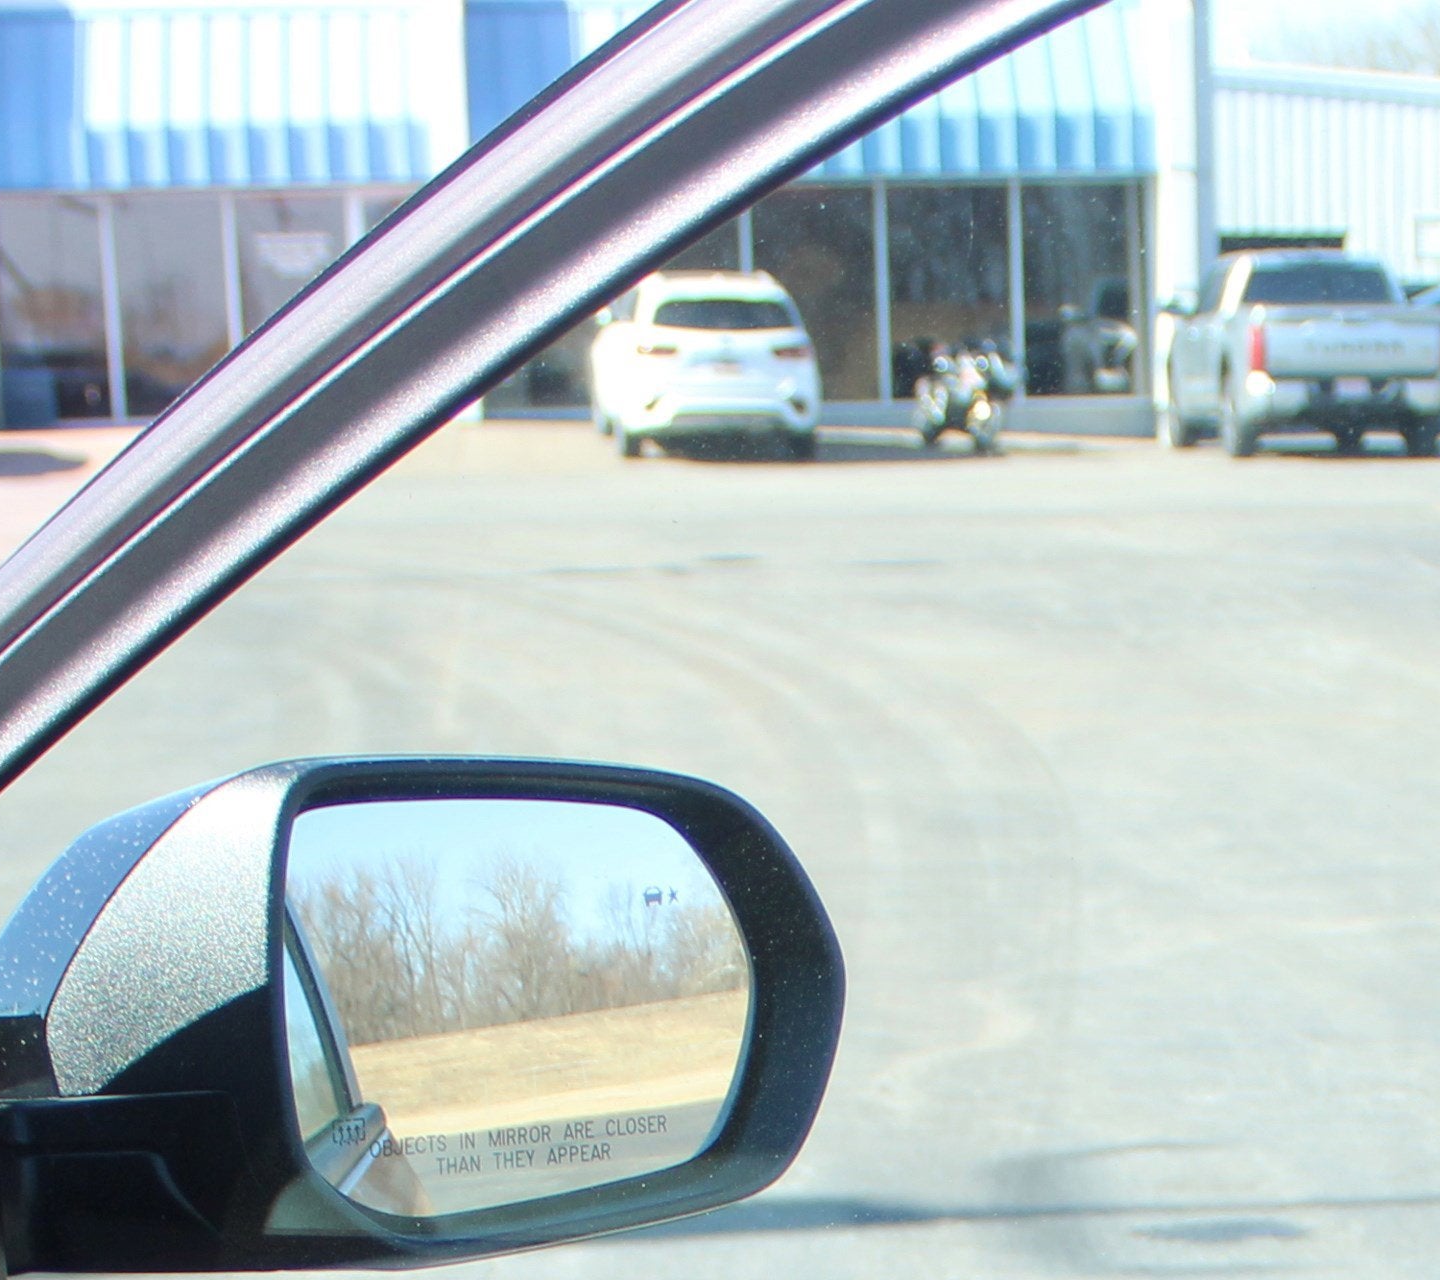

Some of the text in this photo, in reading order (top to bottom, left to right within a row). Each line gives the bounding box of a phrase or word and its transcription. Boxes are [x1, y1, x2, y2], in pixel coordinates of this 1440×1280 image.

[369, 1115, 667, 1158] OBJECTS IN MIRROR ARE CLOSER
[437, 1143, 611, 1175] THAN THEY APPEAR
